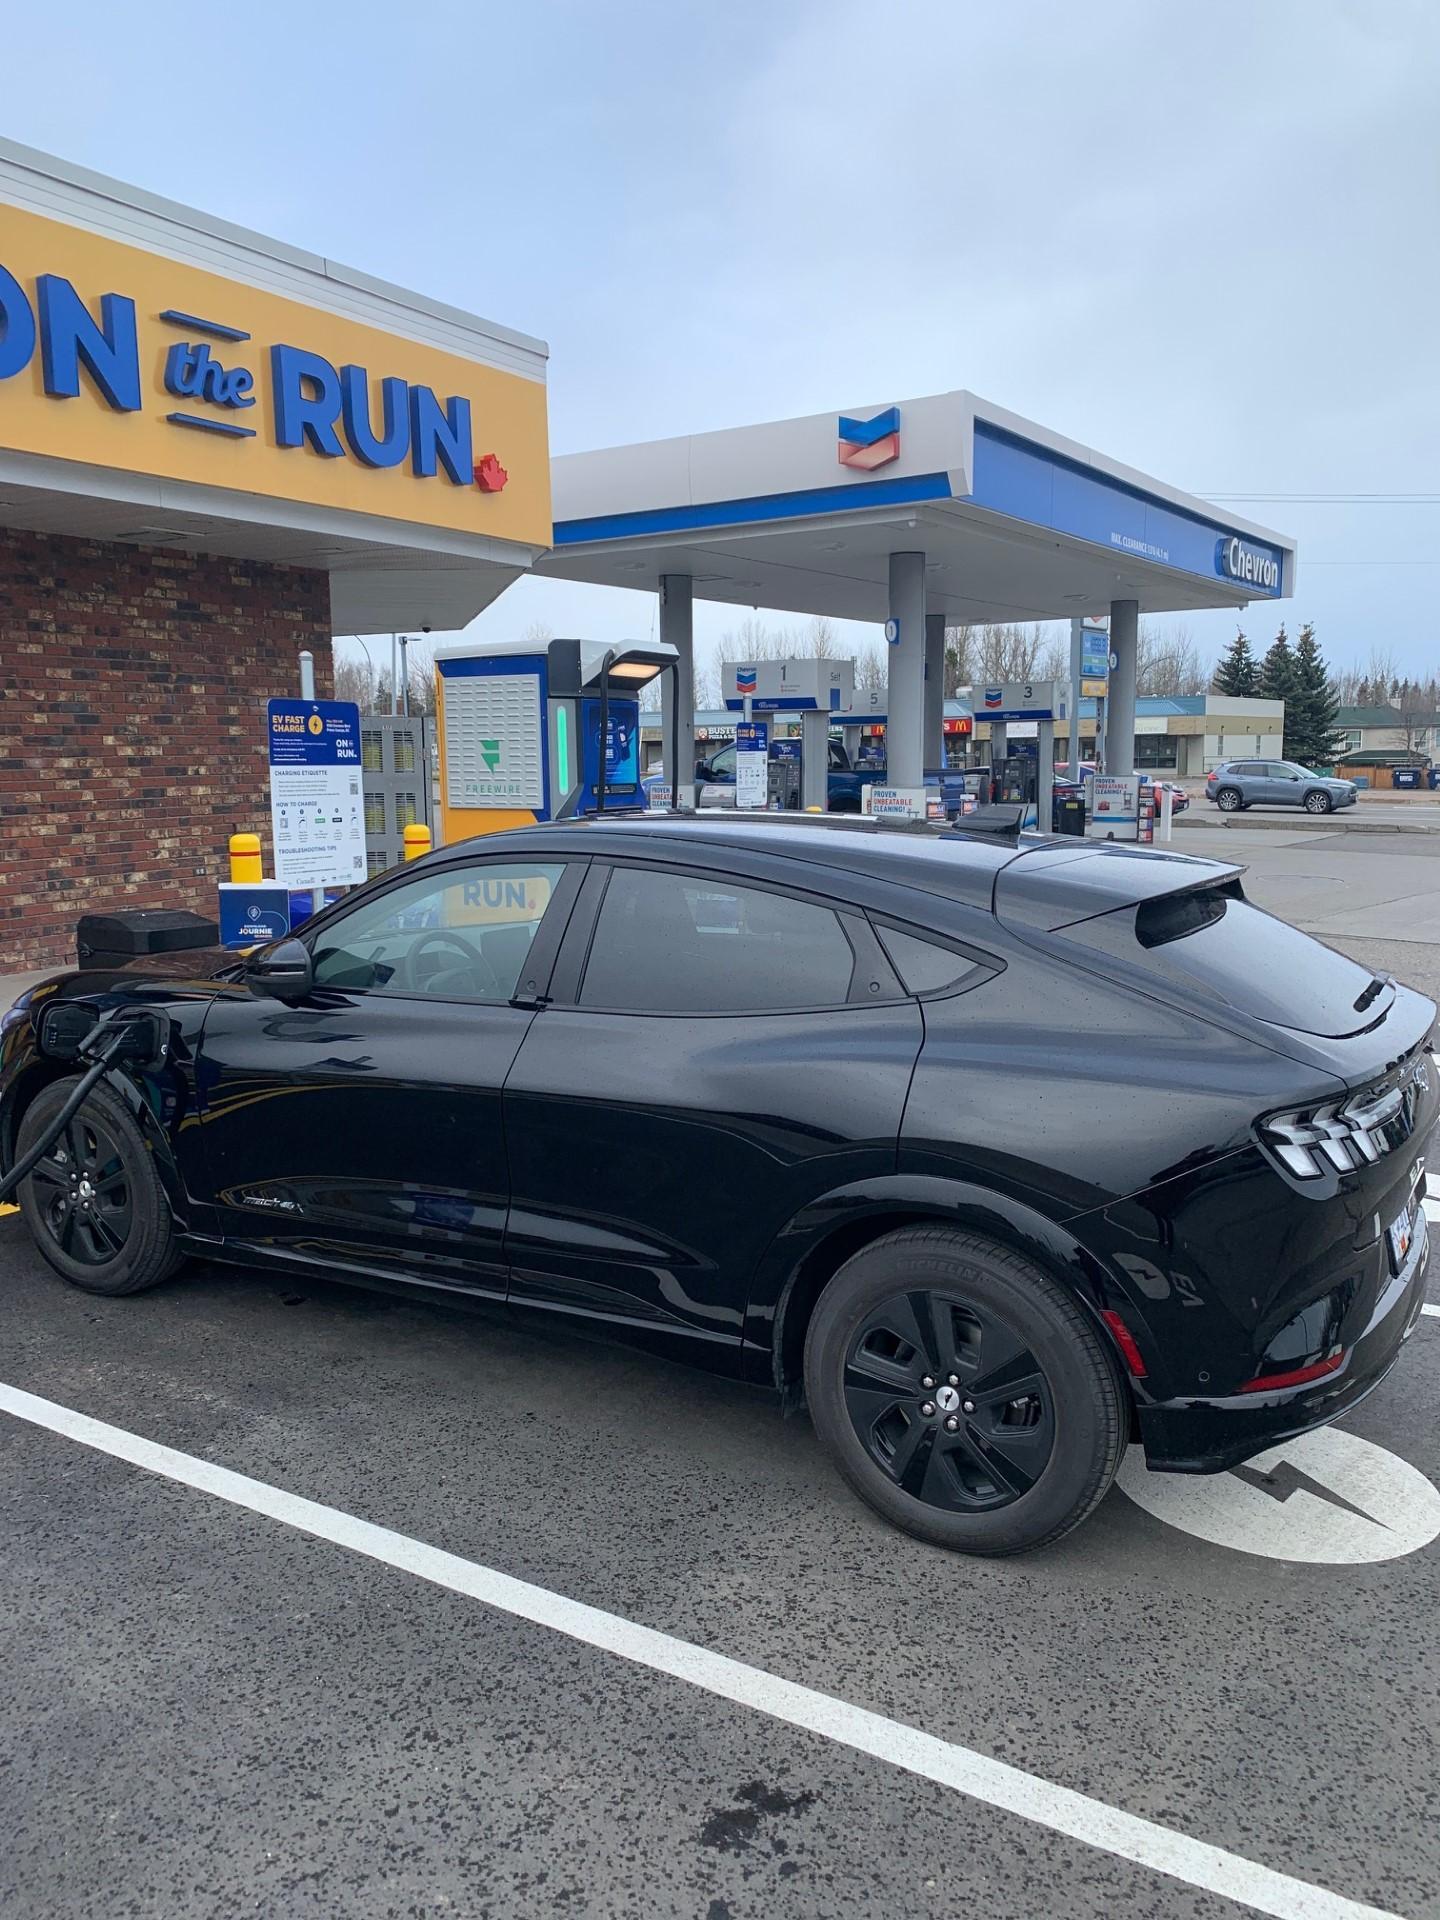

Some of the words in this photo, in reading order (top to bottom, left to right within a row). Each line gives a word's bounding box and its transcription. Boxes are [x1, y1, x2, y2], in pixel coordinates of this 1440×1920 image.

[164, 342, 256, 408] the
[270, 343, 474, 486] RUN
[1229, 536, 1279, 588] Chevron
[781, 665, 787, 681] 1
[1024, 686, 1033, 699] 3
[870, 693, 878, 705] 5
[272, 715, 284, 724] EV
[285, 716, 305, 724] FAST
[272, 724, 306, 733] CHARGE
[709, 727, 737, 735] BUSTE
[336, 739, 348, 748] ON
[466, 784, 521, 794] FREEWIRE
[873, 790, 897, 798] PROVEN
[873, 798, 912, 806] UNBEATABLE
[873, 805, 906, 813] CLEANING!
